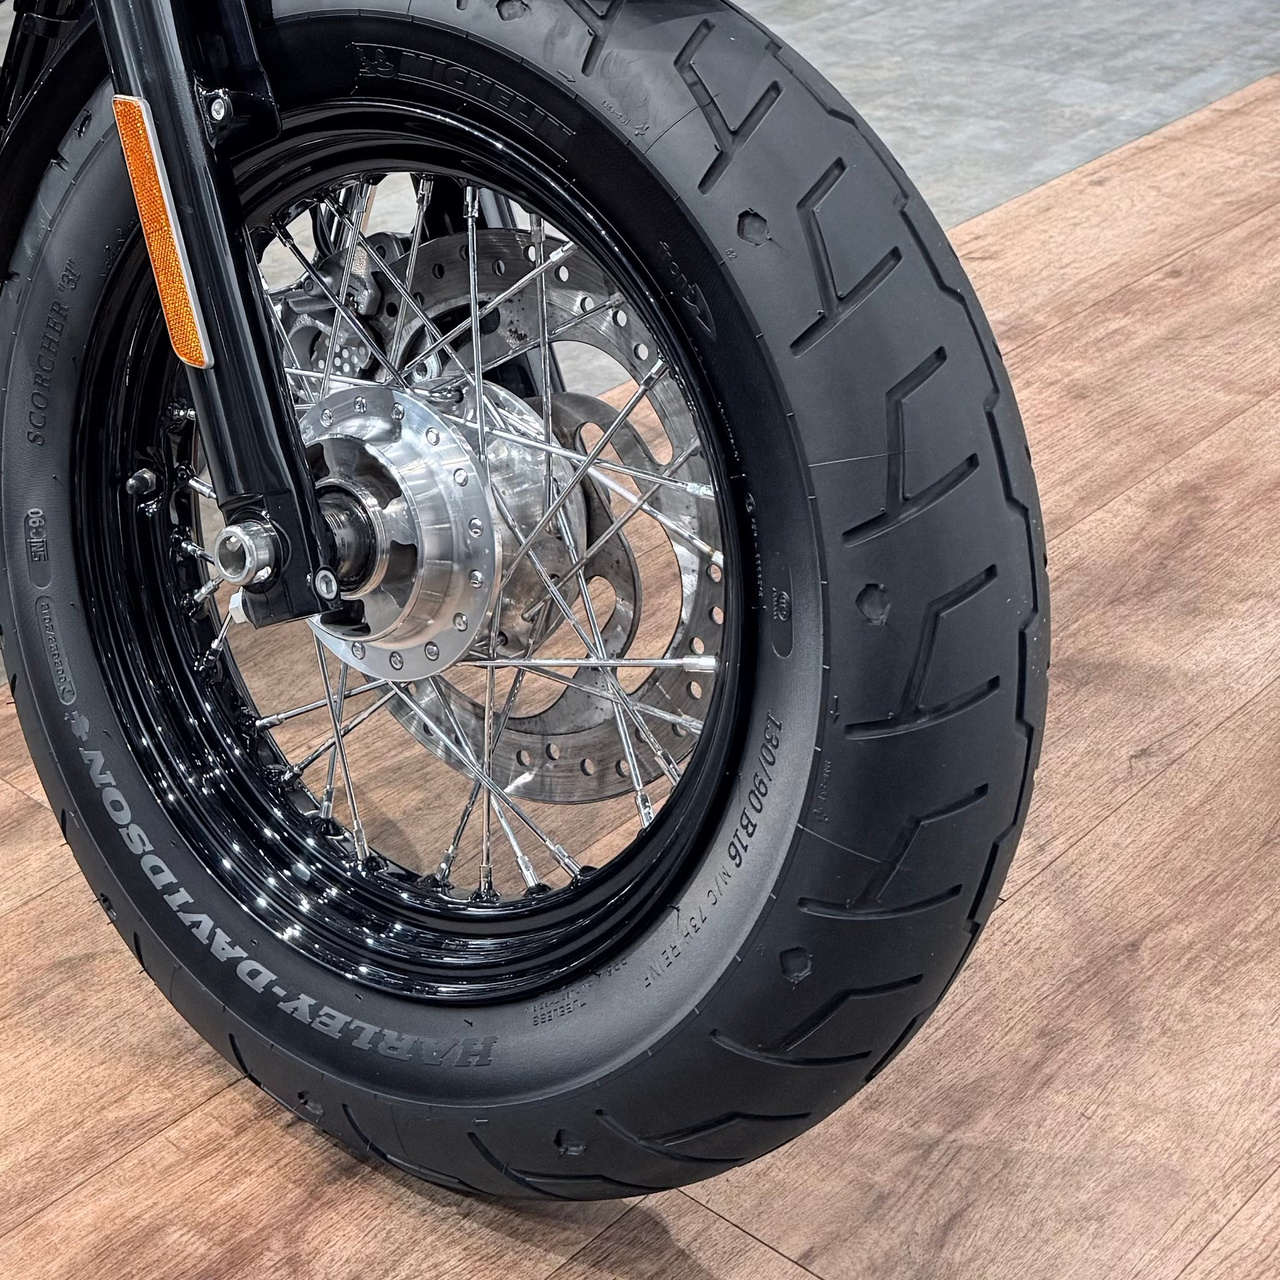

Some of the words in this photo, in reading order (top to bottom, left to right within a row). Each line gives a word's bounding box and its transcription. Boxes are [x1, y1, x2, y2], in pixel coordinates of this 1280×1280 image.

[25, 294, 70, 447] SCORCHER
[748, 709, 783, 814] 130/90
[80, 746, 499, 1068] HARLEY-DAVIDSON
